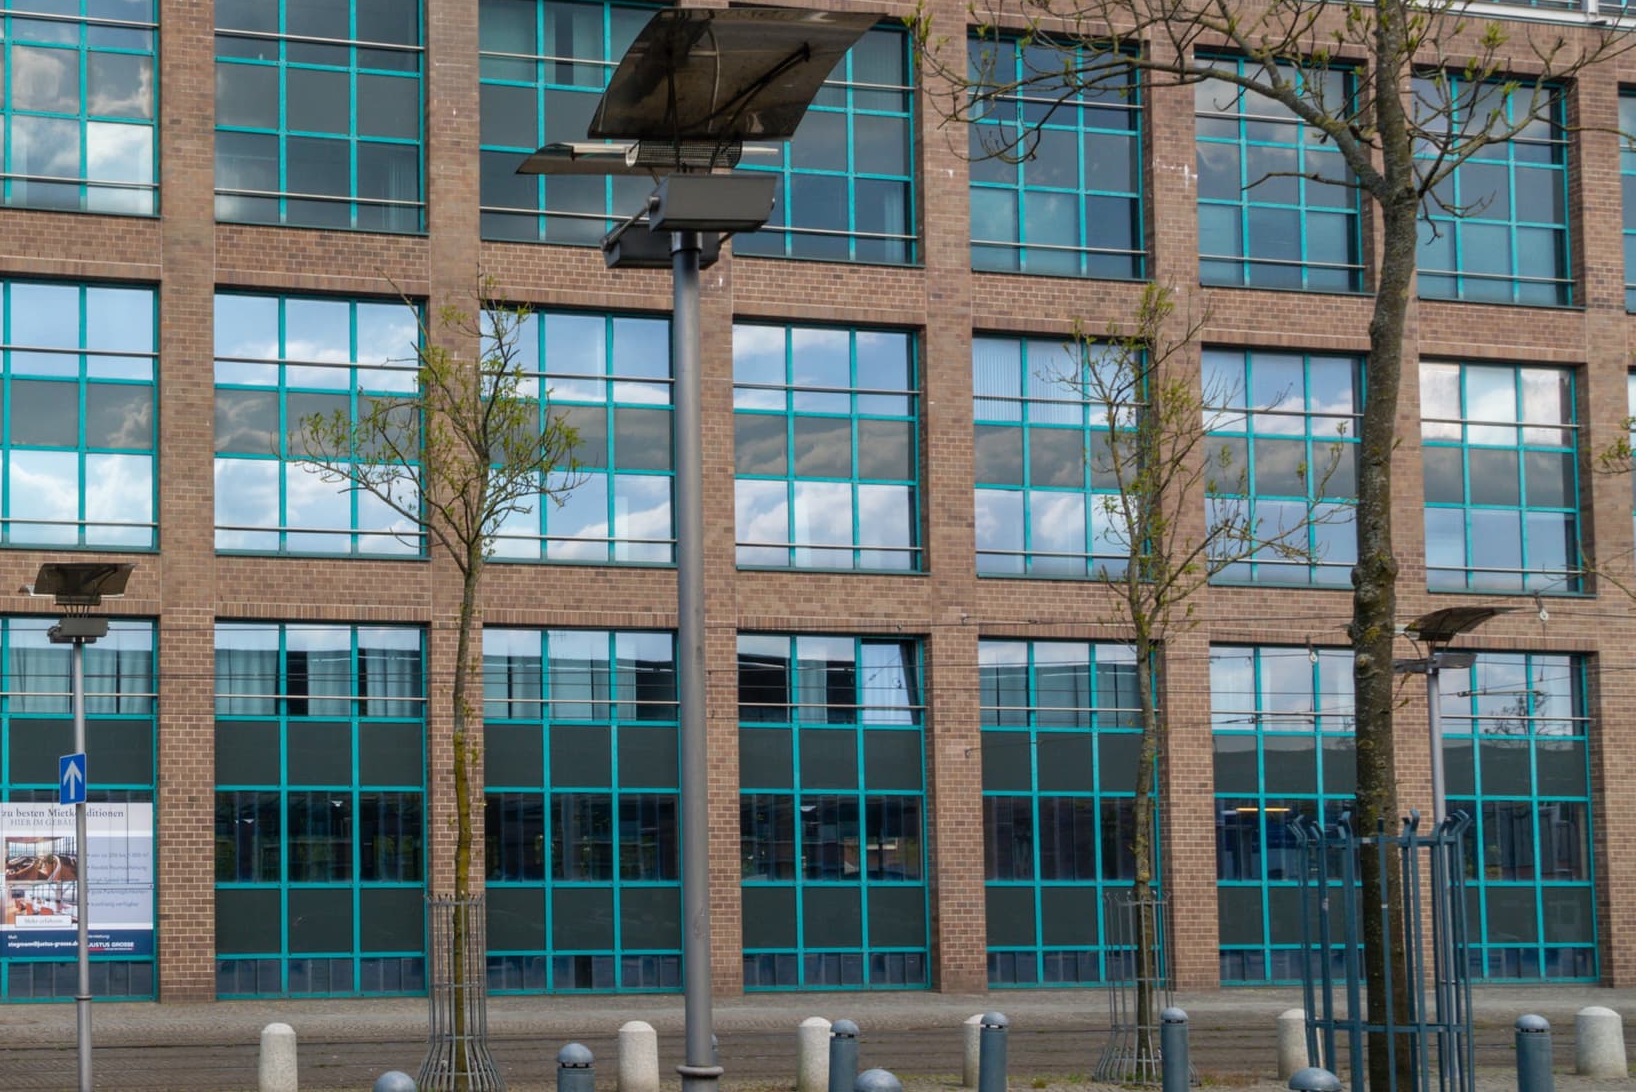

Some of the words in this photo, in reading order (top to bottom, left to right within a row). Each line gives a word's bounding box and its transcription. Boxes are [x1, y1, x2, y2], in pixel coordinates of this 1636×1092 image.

[1, 810, 14, 818] zu
[15, 807, 45, 818] besten
[48, 807, 124, 818] Mietkditionen
